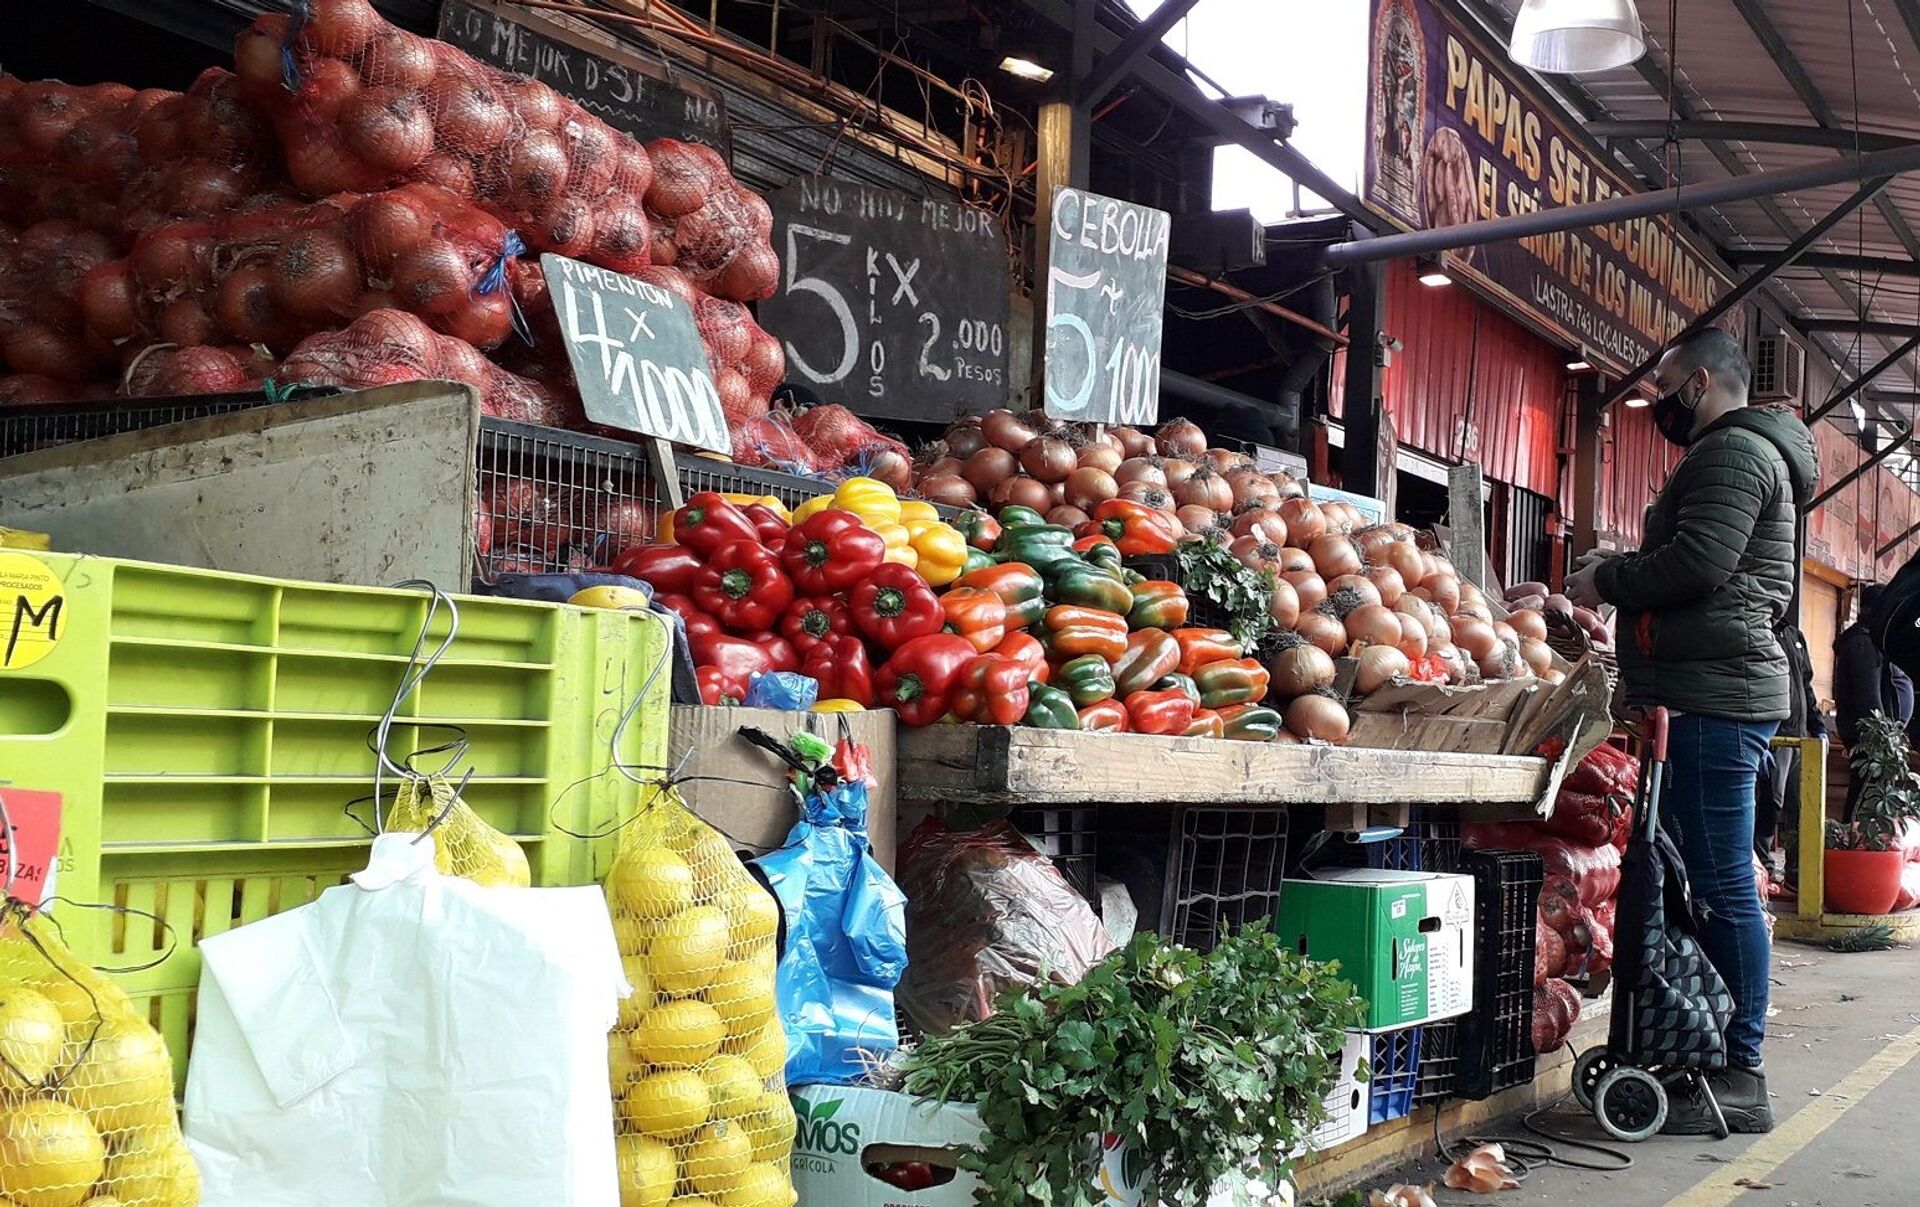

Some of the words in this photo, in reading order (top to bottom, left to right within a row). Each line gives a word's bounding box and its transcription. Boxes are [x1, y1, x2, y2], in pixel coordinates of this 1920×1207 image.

[490, 18, 573, 85] MEJOR
[800, 177, 842, 215] NO
[921, 200, 994, 238] MEJOR
[1446, 34, 1542, 183] PAPAS
[1548, 135, 1718, 316] SELECCIONADAS
[1053, 188, 1169, 264] CEBOLLA
[1478, 155, 1502, 219] EL
[1568, 232, 1592, 296] DE
[1595, 252, 1626, 319] LOS
[1628, 278, 1692, 348] MILAGR
[555, 257, 674, 309] PIMENTON
[786, 222, 860, 384] 5
[885, 253, 920, 307] X
[1536, 273, 1575, 326] LASTRA
[1593, 315, 1635, 364] LOCALES
[563, 279, 625, 381] 4
[954, 357, 1003, 386] PESOS
[610, 350, 734, 455] 1000
[1105, 336, 1160, 426] 1000
